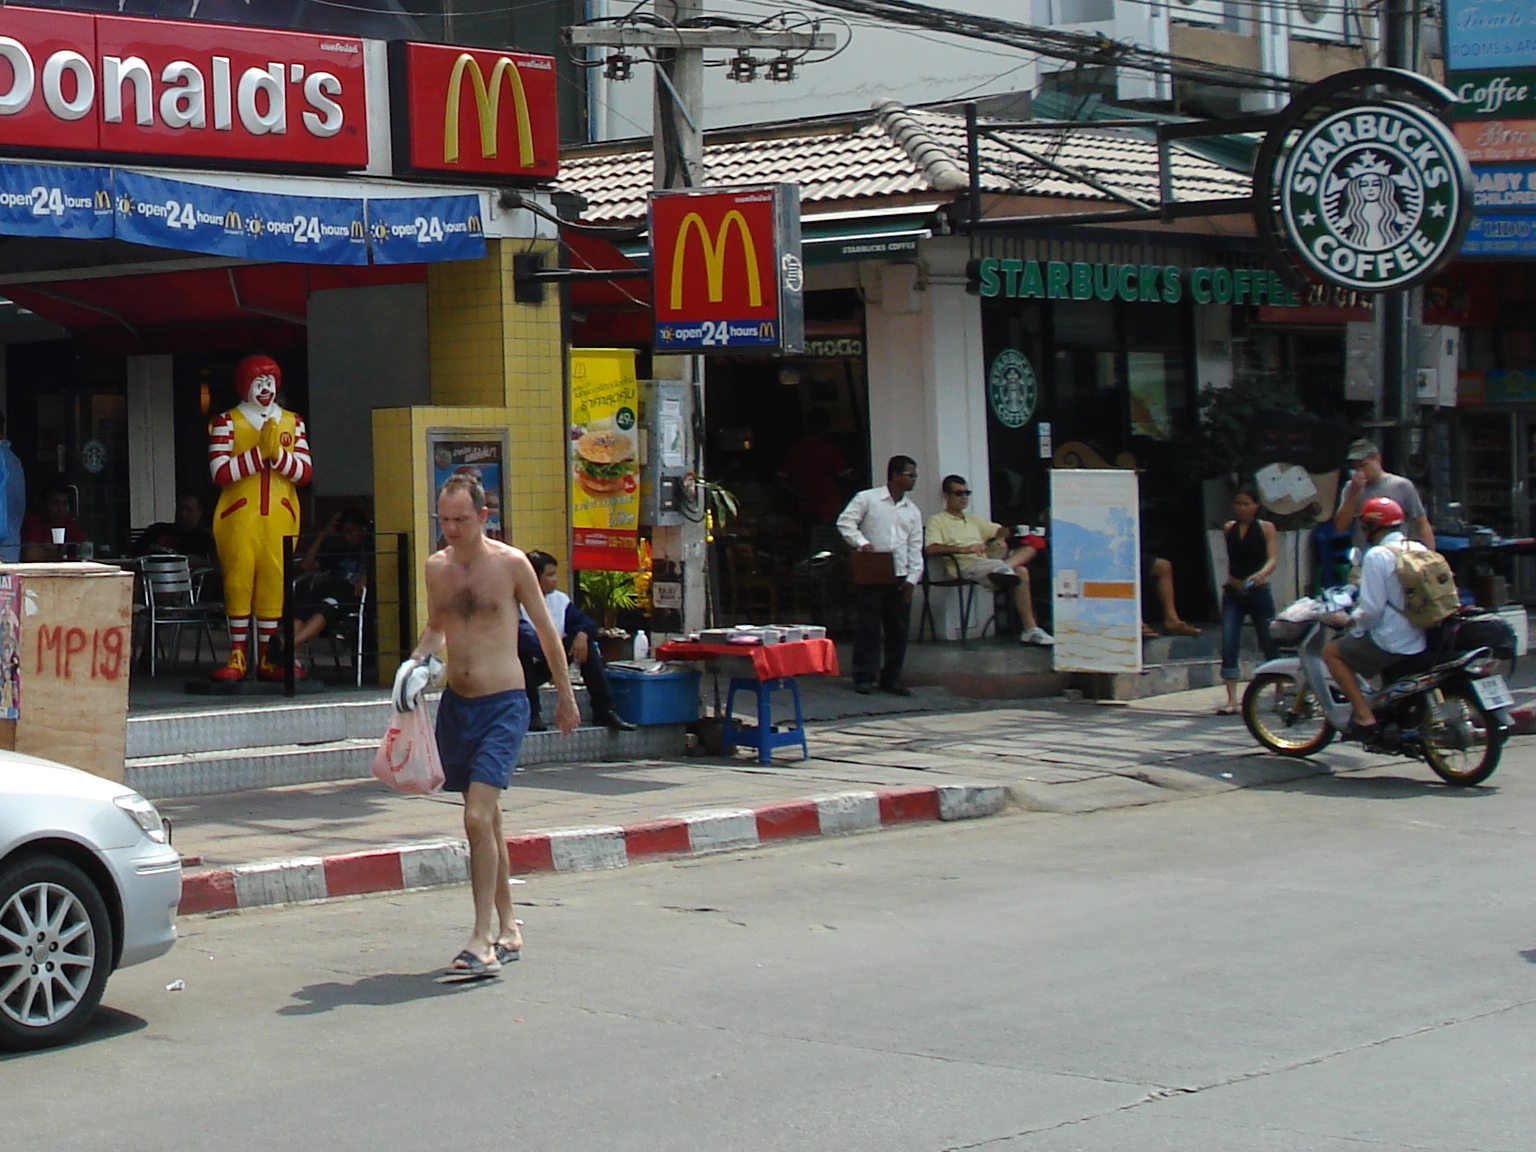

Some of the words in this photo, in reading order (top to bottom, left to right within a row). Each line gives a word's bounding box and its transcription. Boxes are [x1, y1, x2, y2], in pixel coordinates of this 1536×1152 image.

[1458, 76, 1528, 113] Coffee
[1294, 114, 1449, 196] STARBUCKS
[0, 191, 32, 208] open
[31, 186, 65, 216] 24
[137, 202, 168, 218] open
[166, 200, 197, 230] 24
[196, 209, 225, 226] hours
[267, 220, 295, 235] open
[293, 215, 321, 243] 24
[321, 223, 349, 237] hours
[391, 222, 417, 237] open
[415, 216, 444, 243] 24
[443, 219, 467, 234] hours
[1314, 229, 1436, 278] COFFEE
[979, 258, 1183, 303] STARBUCKS
[1191, 267, 1302, 307] COFFEE
[675, 327, 703, 342] open
[701, 320, 730, 346] 24
[729, 325, 758, 338] hours
